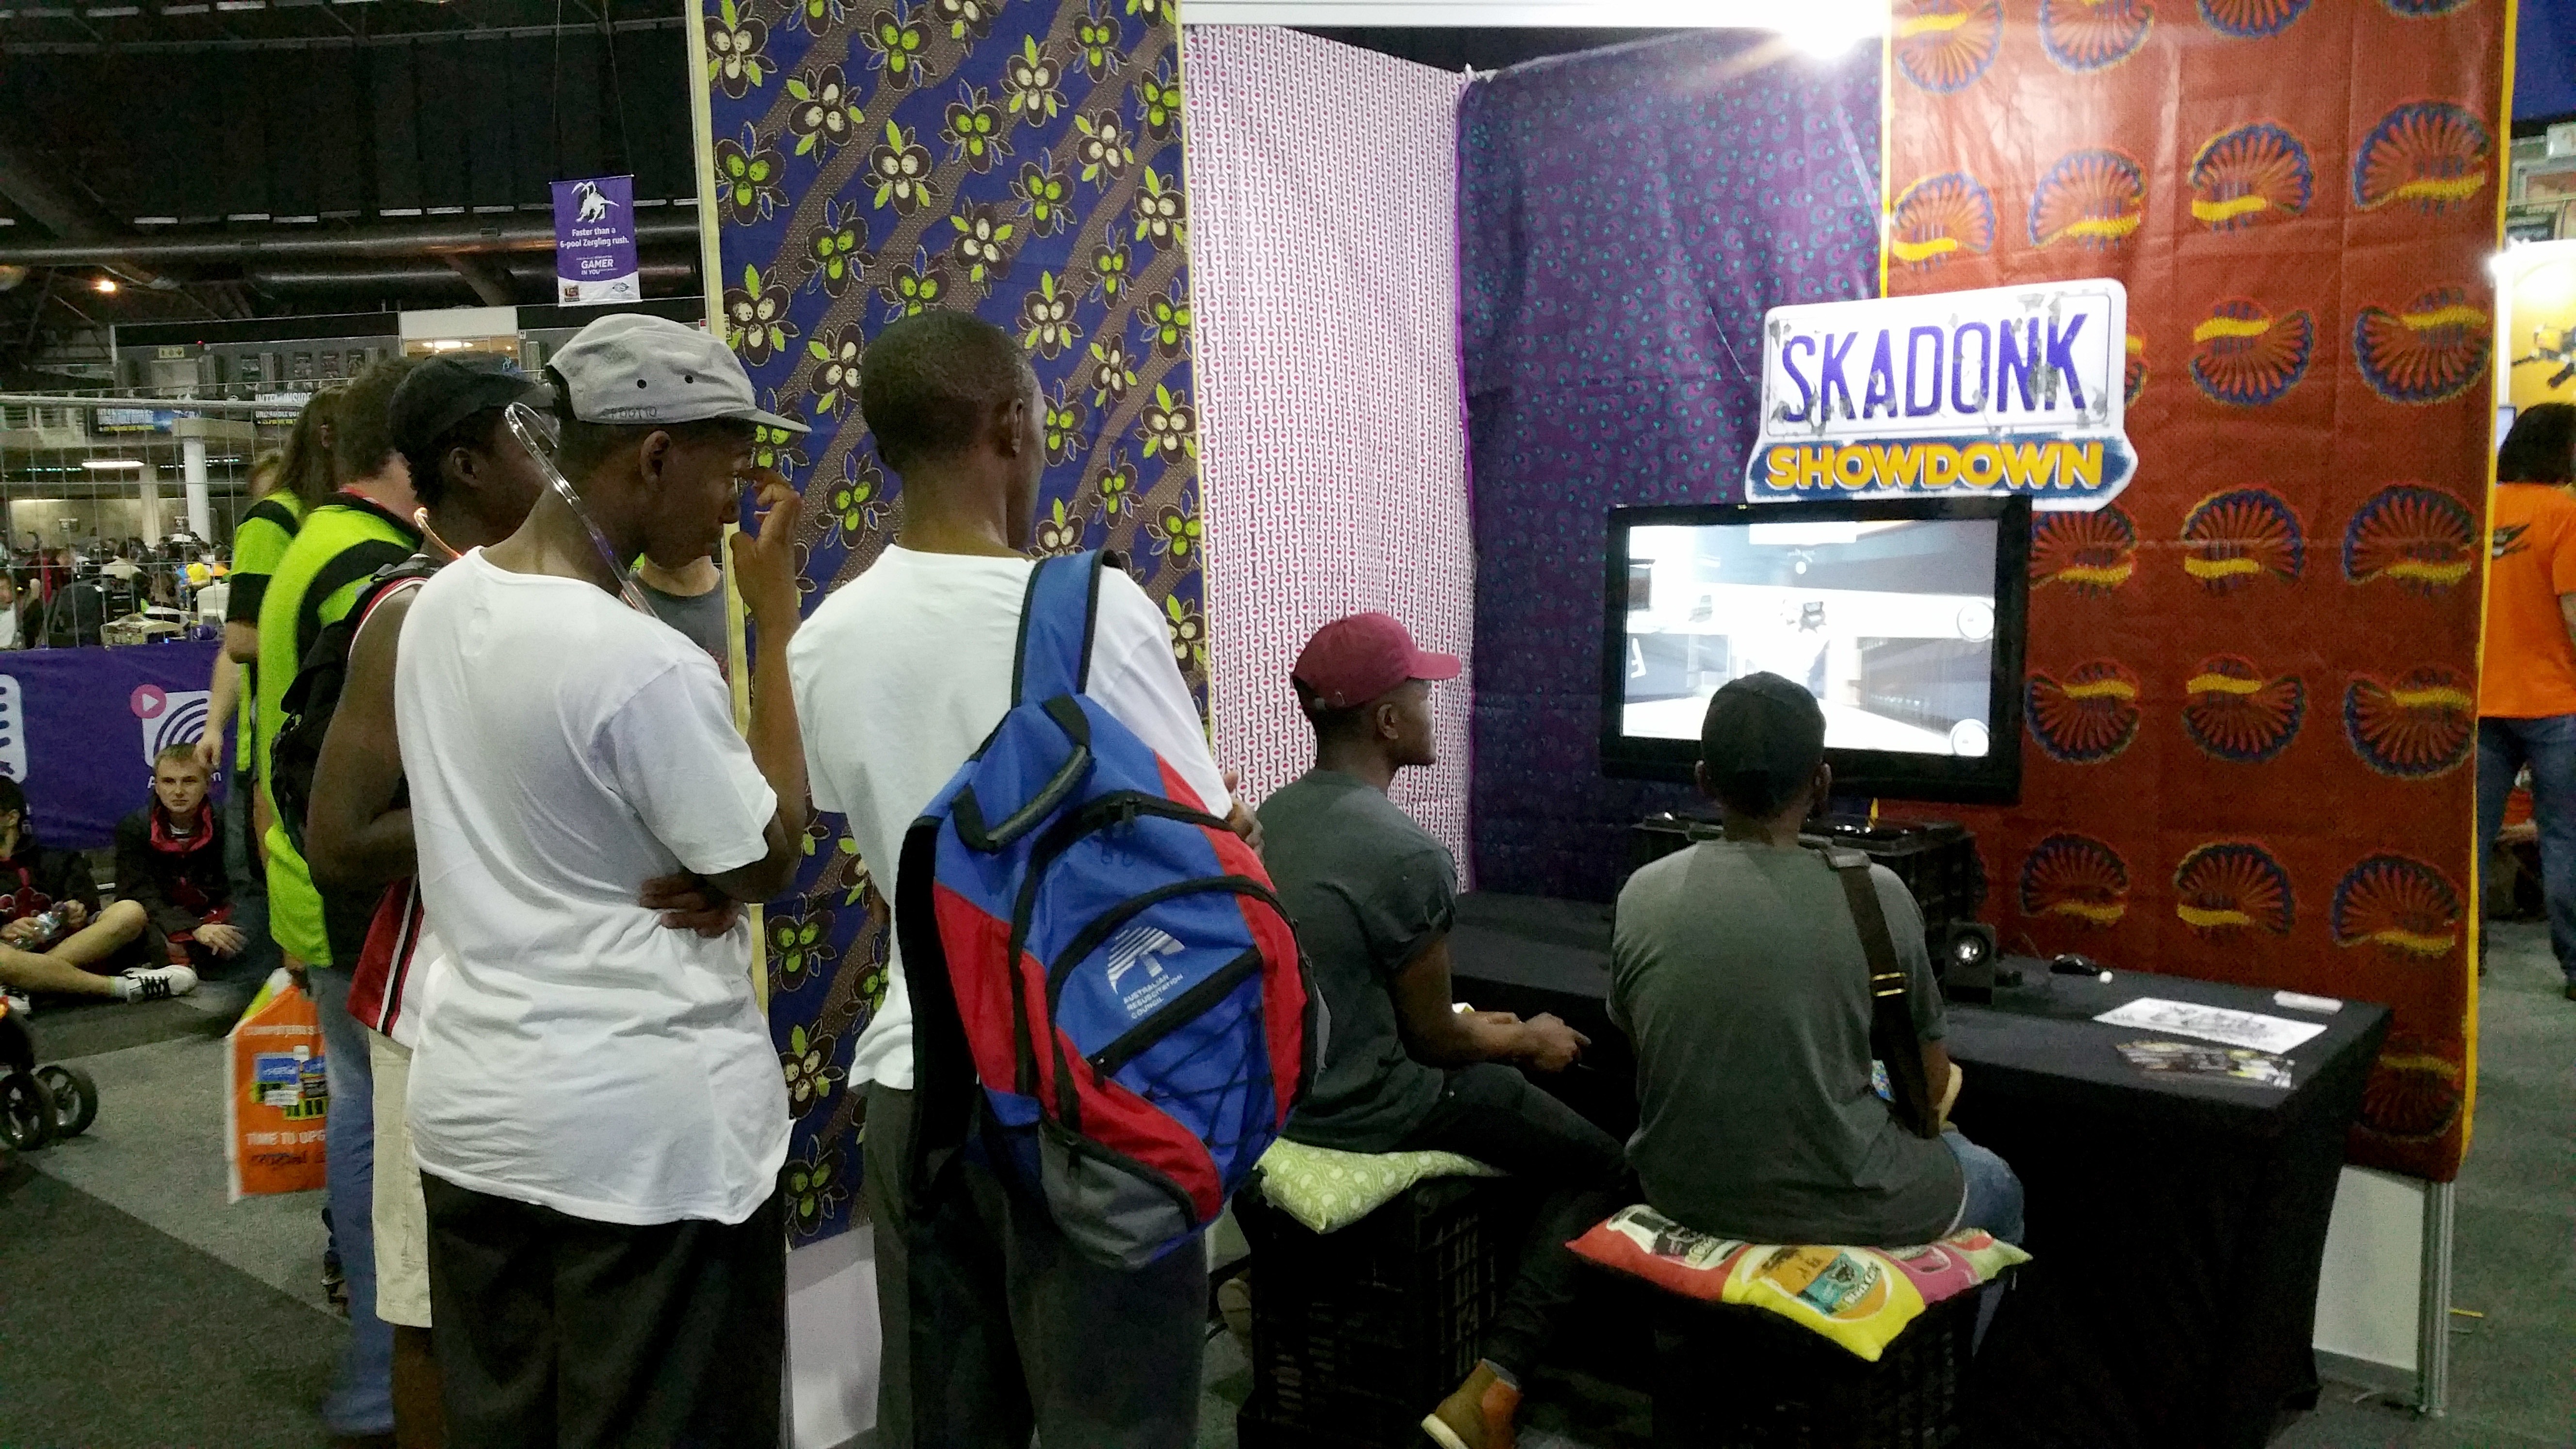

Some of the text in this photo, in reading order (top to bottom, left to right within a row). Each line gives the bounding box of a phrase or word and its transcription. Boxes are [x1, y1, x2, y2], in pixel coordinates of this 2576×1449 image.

[560, 235, 629, 249] 6-pool Zergling rush.
[581, 258, 614, 269] GAMER
[1782, 313, 2088, 422] SKADONK
[1765, 441, 2104, 491] SHOWDOWN
